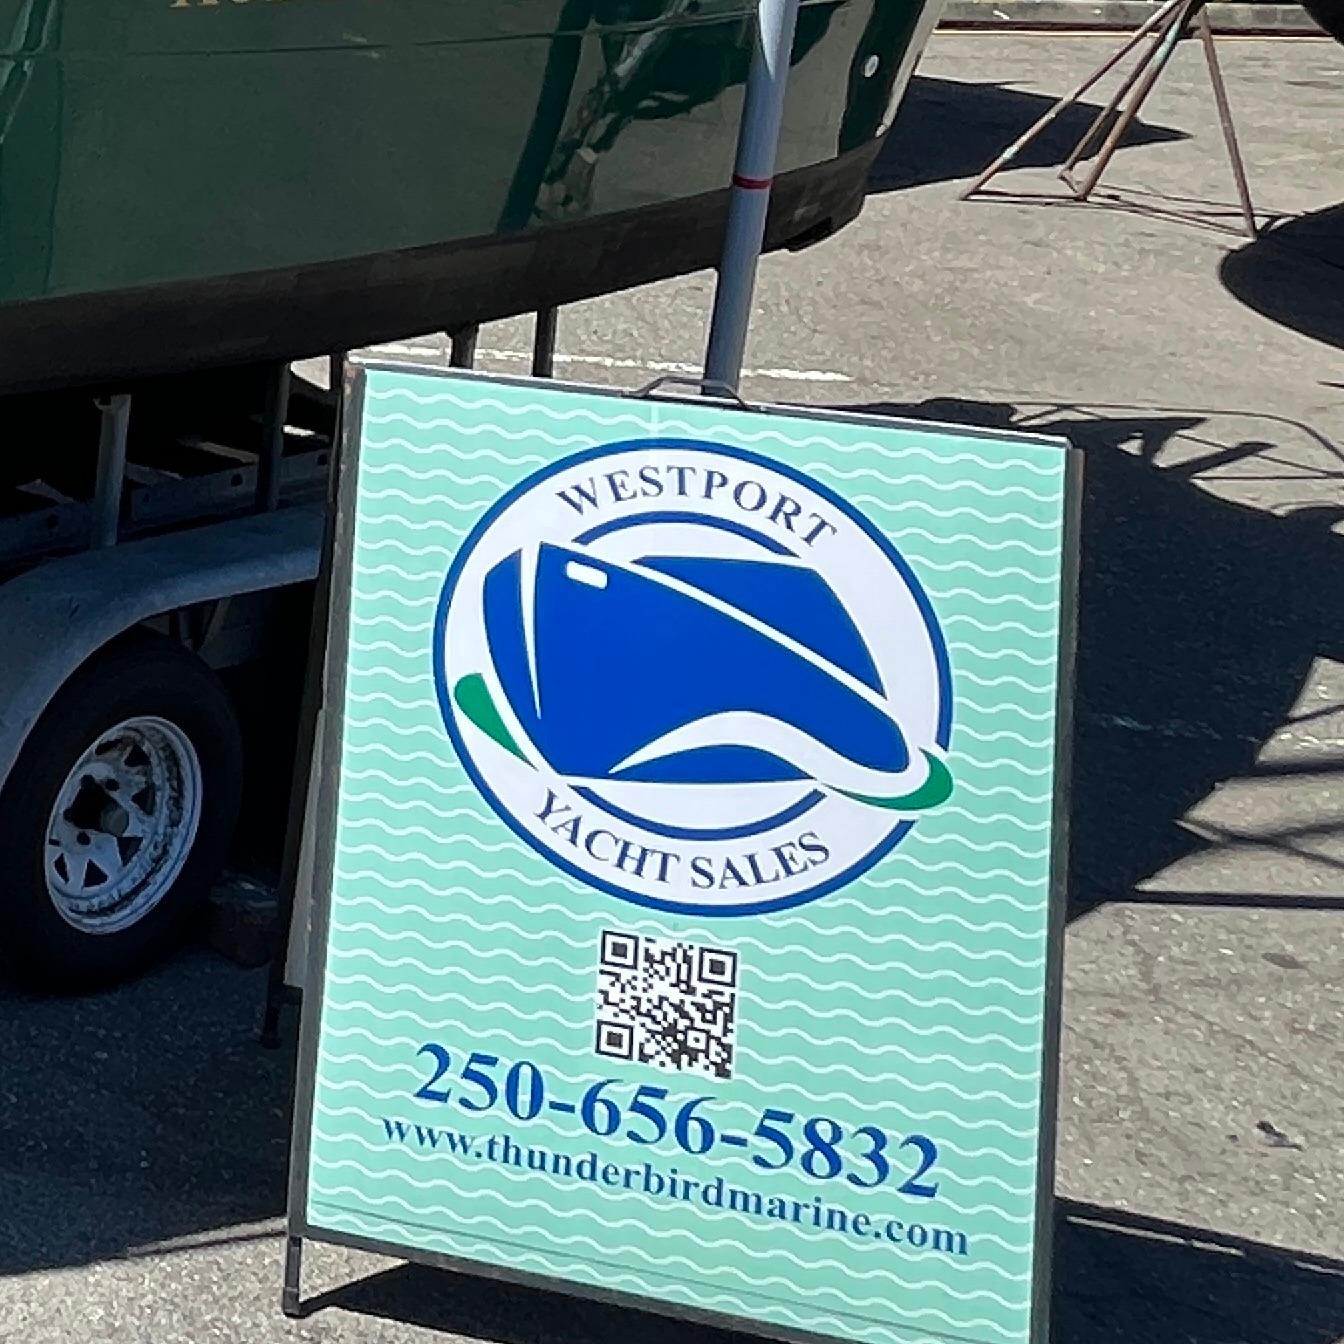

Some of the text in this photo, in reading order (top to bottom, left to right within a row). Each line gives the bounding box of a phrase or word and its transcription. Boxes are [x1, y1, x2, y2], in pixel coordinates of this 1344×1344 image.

[554, 464, 839, 548] WESTPORT
[533, 786, 831, 890] YACHT SALES
[413, 1042, 940, 1199] 250-656-5832
[381, 1115, 969, 1256] www.thunderbirdmarine.com
